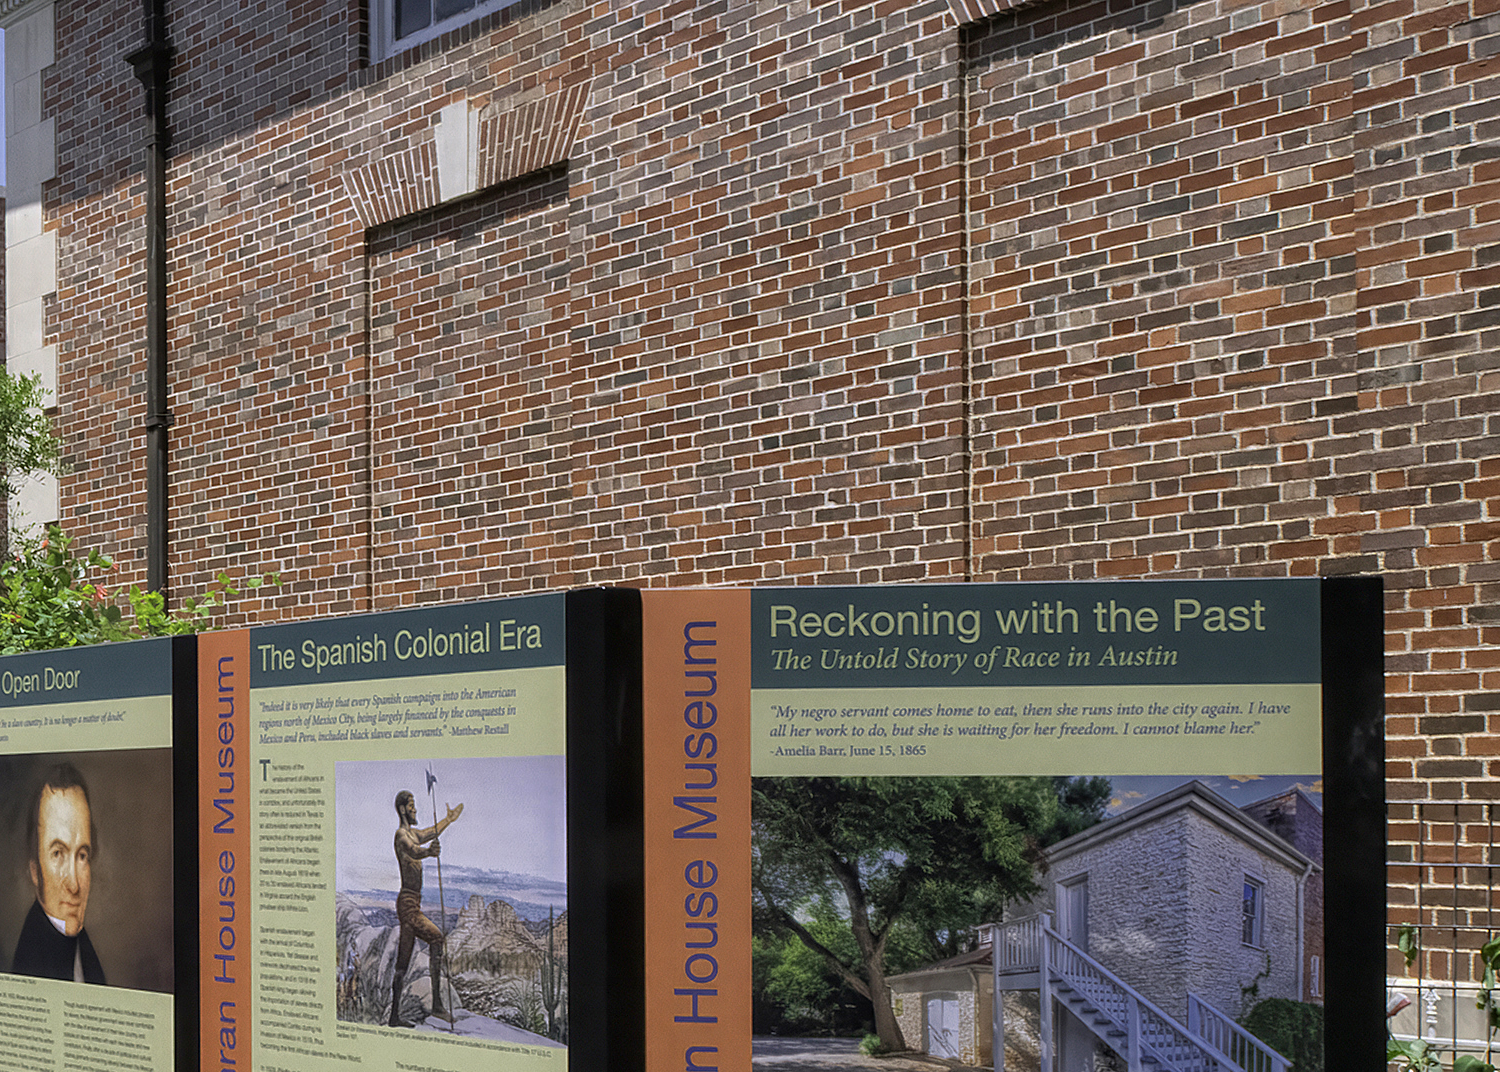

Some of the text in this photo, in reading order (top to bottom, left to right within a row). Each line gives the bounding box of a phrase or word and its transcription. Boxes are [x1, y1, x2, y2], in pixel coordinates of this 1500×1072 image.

[770, 598, 1266, 644] Reckoning with the Past
[257, 618, 542, 674] The Spanish Colonial Era
[771, 645, 1177, 675] The Untold Story of Race in Austin
[1, 671, 40, 698] Open
[44, 667, 80, 690] Door
[672, 620, 718, 840] Museum
[769, 723, 787, 737] all
[789, 723, 812, 737] her
[815, 723, 848, 737] work
[851, 726, 865, 737] to
[867, 723, 887, 737] do,
[891, 723, 914, 736] but
[917, 723, 939, 736] she
[942, 723, 953, 736] is
[957, 723, 1008, 740] waiting
[1007, 722, 1030, 739] for
[1033, 722, 1058, 736] her
[1056, 722, 1118, 739] freedom.
[1122, 722, 1129, 735] I
[1132, 724, 1180, 735] cannot
[1183, 721, 1226, 734] blame
[800, 708, 837, 722] negro
[840, 706, 889, 718] servant
[892, 707, 933, 717] comes
[936, 703, 974, 716] home
[977, 705, 991, 716] to
[994, 705, 1018, 717] eat,
[1022, 702, 1052, 716] then
[1056, 702, 1078, 716] she
[1082, 706, 1113, 716] runs
[1116, 703, 1144, 715] into
[1147, 702, 1169, 715] the
[1172, 702, 1198, 718] city
[1200, 702, 1243, 719] again.
[1248, 701, 1254, 714] I
[1257, 700, 1291, 714] have
[214, 656, 234, 834] Museum
[770, 744, 926, 757] -Amelia Barr, June 15, 1865
[214, 850, 236, 984] House
[674, 860, 718, 1024] House
